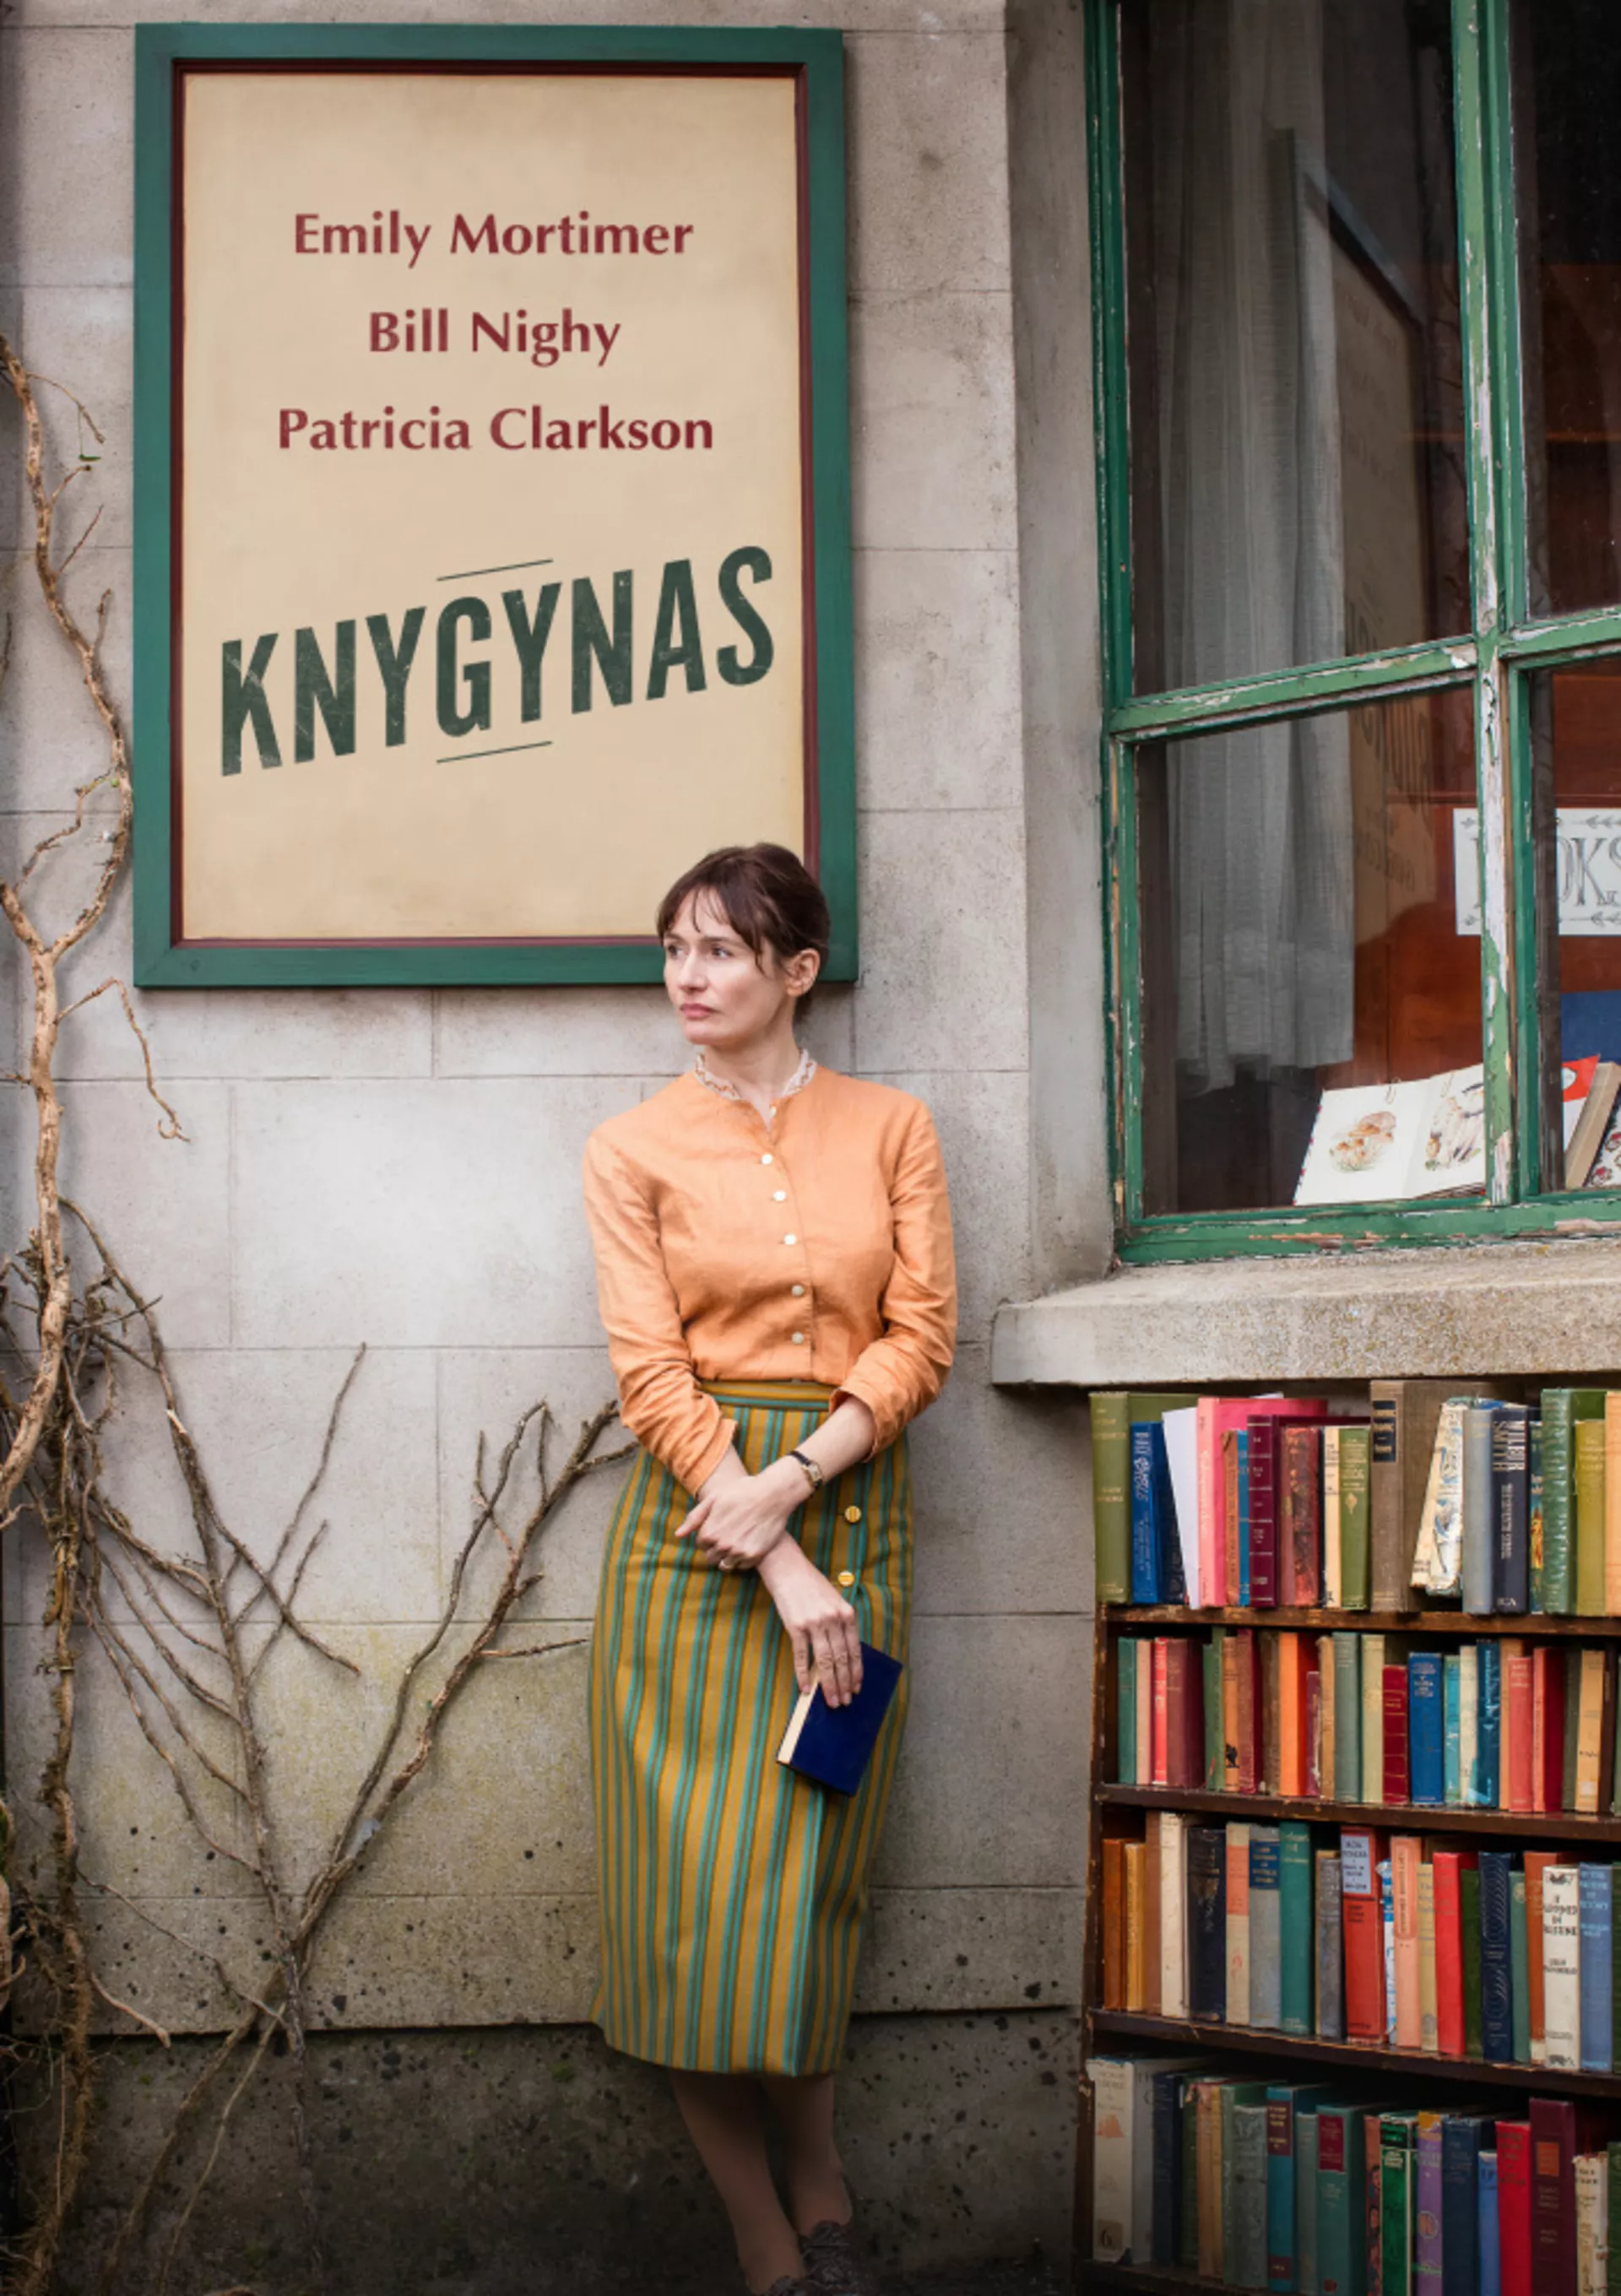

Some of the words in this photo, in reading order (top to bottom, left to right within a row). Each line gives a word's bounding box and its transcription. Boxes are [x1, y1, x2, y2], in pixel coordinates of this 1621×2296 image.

[295, 210, 430, 266] Emily
[451, 210, 694, 255] Mortimer
[370, 308, 448, 352] Bill
[472, 308, 621, 366] Nighy
[279, 405, 470, 450] Patricia
[490, 405, 713, 450] Clarkson
[222, 545, 774, 776] KNYGYNAS
